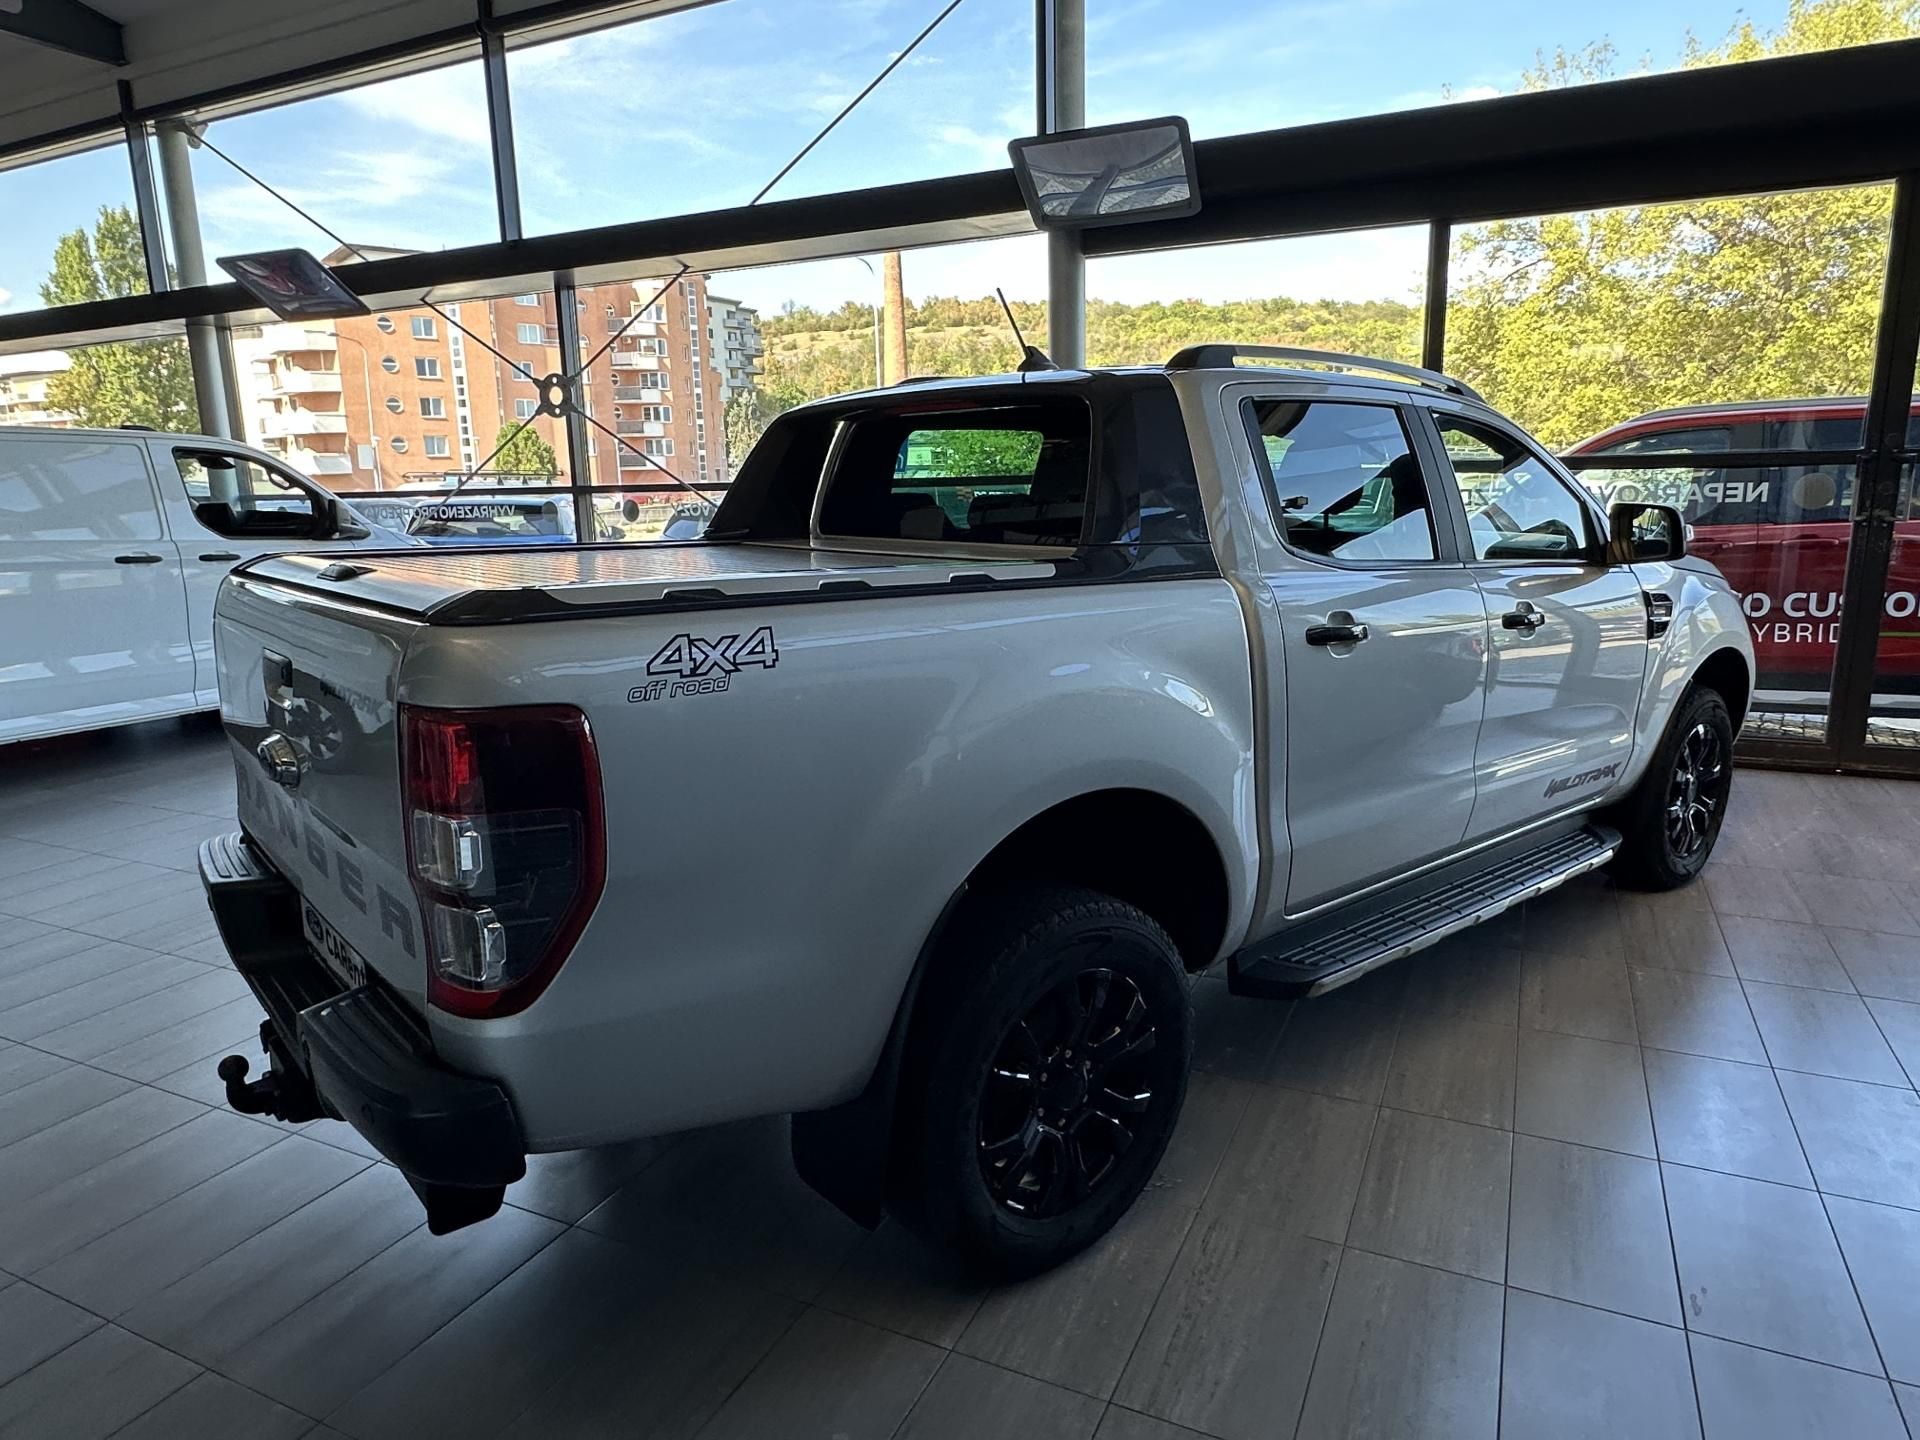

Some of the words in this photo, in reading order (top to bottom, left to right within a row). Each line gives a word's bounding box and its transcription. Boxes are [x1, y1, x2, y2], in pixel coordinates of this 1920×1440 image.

[1751, 623, 1841, 643] YBRID
[627, 679, 668, 703] off
[670, 672, 731, 699] road
[1543, 761, 1622, 799] WILDTRAK
